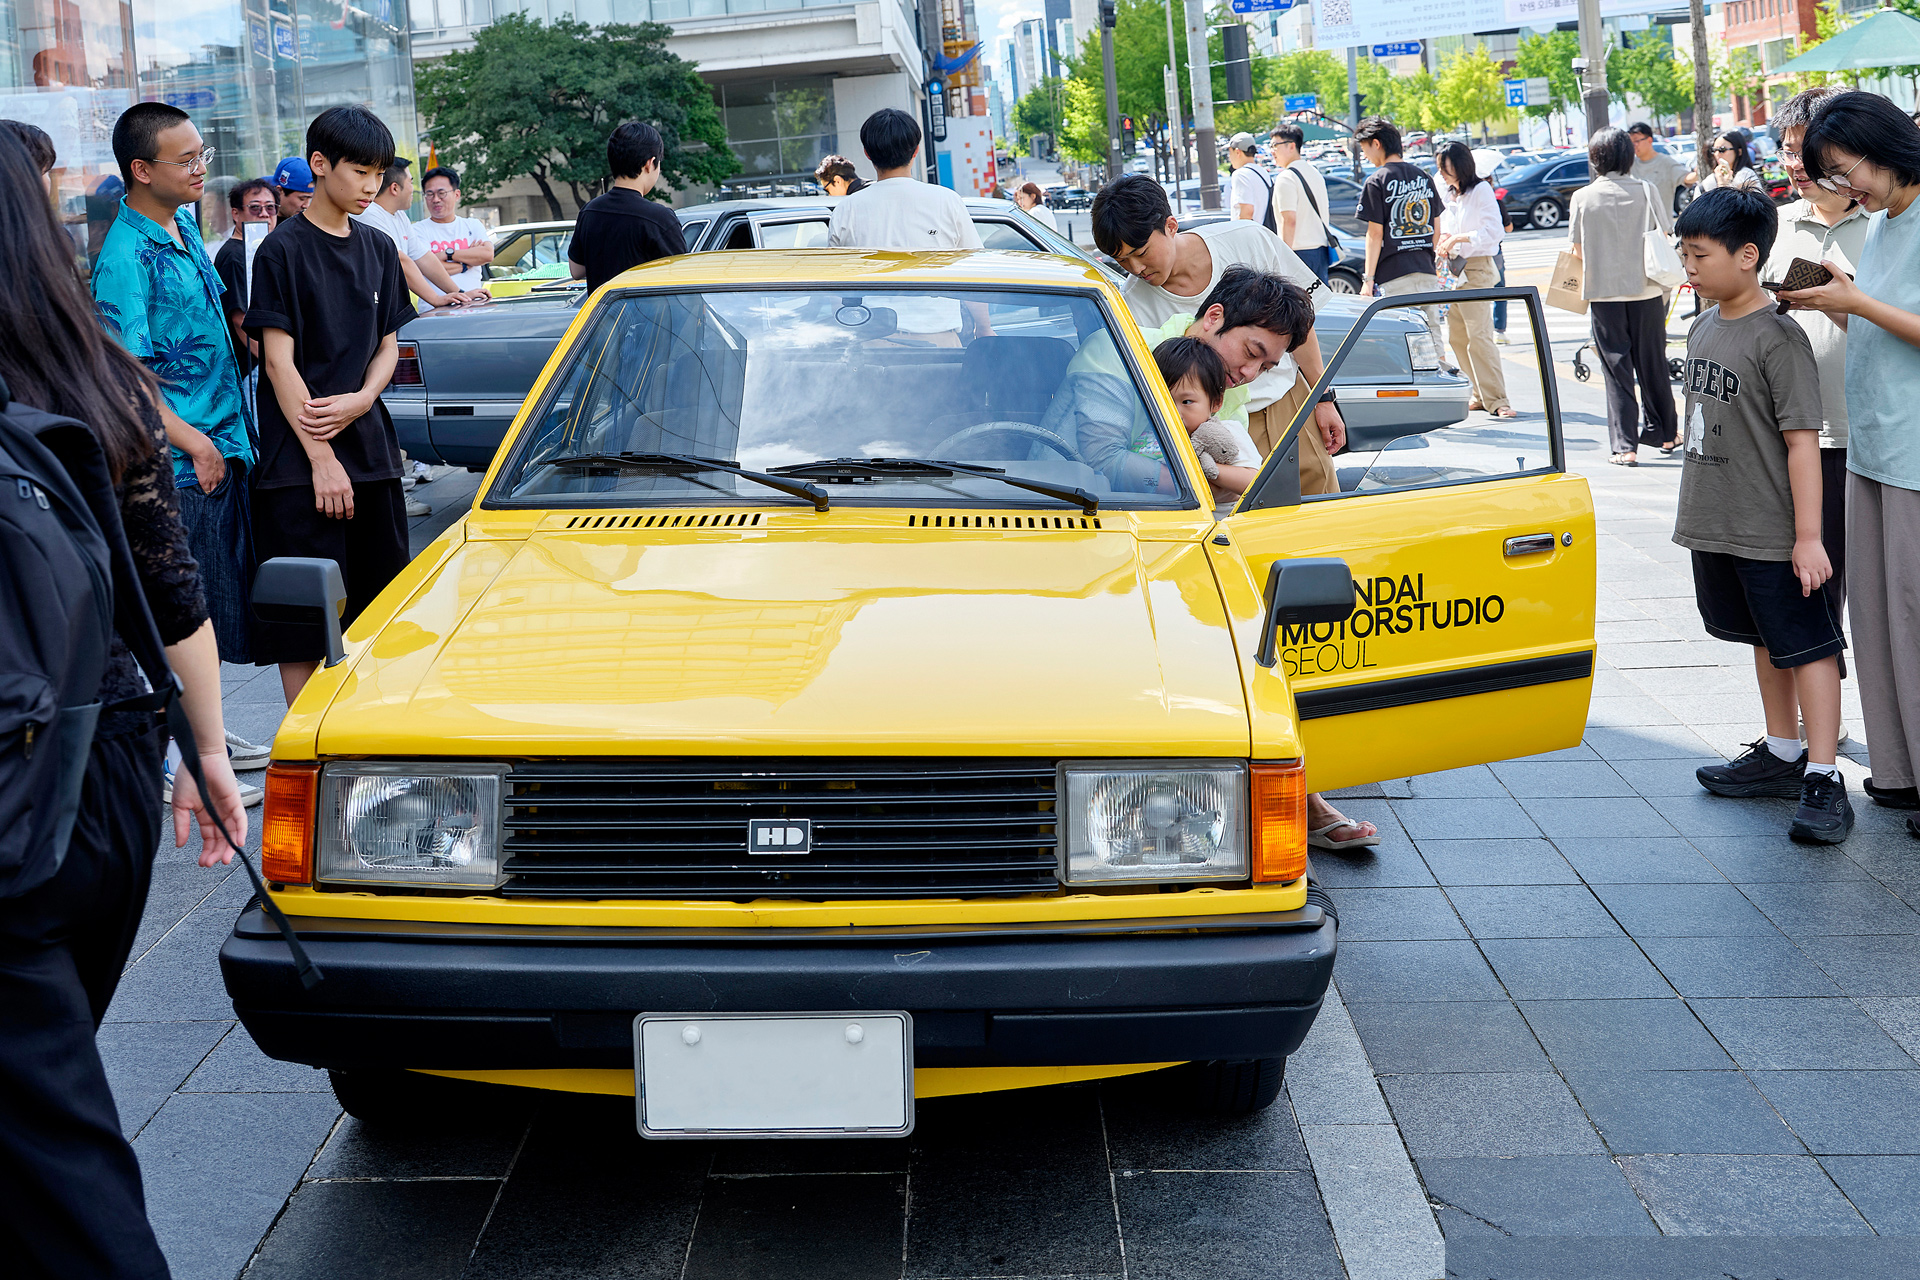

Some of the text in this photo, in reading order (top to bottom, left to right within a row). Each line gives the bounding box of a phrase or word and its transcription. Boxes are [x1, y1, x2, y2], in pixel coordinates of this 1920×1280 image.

[1385, 175, 1429, 203] Liberty
[1711, 423, 1722, 436] 41
[1352, 573, 1424, 608] NDAI
[1281, 595, 1505, 646] MOTORSTUDIO
[1282, 640, 1377, 677] SEOUL
[757, 827, 804, 846] HD
